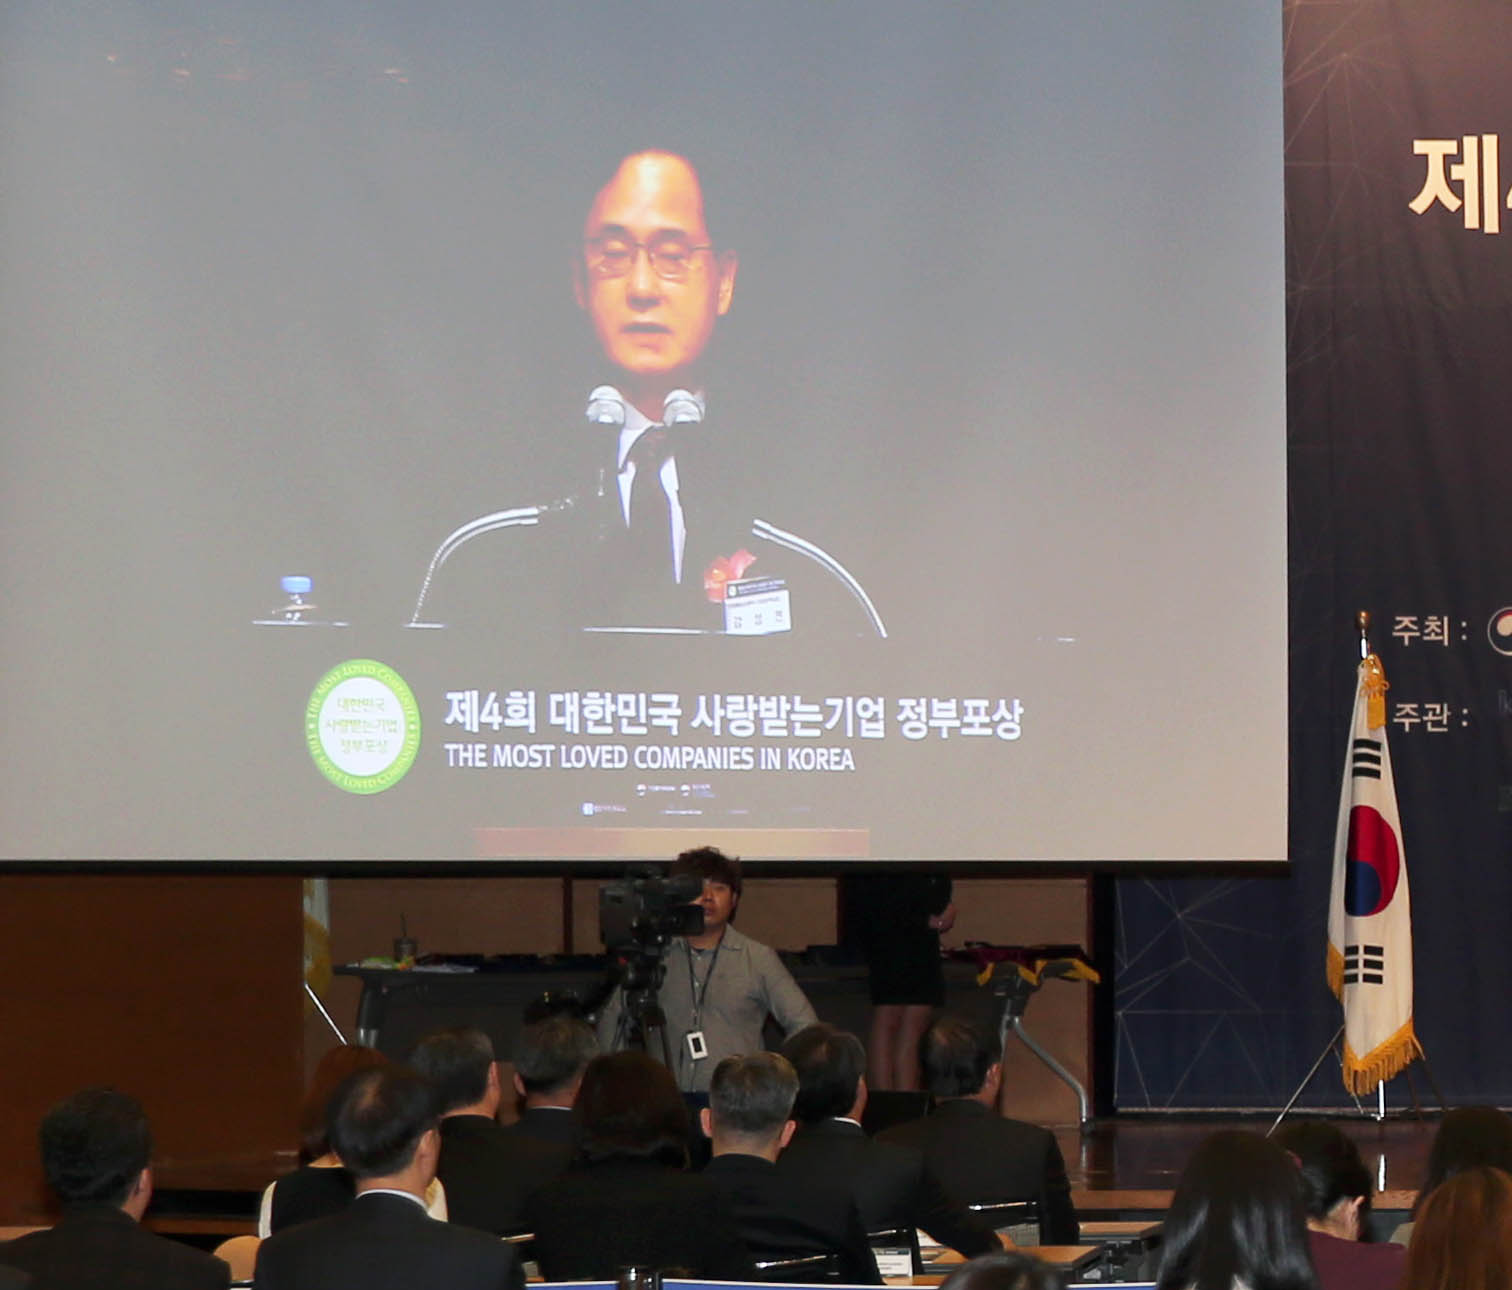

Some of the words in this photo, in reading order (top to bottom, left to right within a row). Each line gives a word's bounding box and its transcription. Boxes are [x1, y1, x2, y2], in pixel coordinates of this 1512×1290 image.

[1392, 615, 1449, 647] 주최
[445, 690, 536, 733] 제4회
[549, 691, 682, 735] 대한민국
[690, 693, 885, 738] 사랑받는기업
[896, 697, 1025, 740] 정부포상
[1392, 703, 1451, 733] 주관
[444, 743, 488, 767] THE
[493, 744, 555, 768] MOST
[560, 744, 628, 768] LOVED
[634, 745, 754, 770] COMPANIES
[760, 747, 781, 770] IN
[787, 747, 856, 771] KOREA
